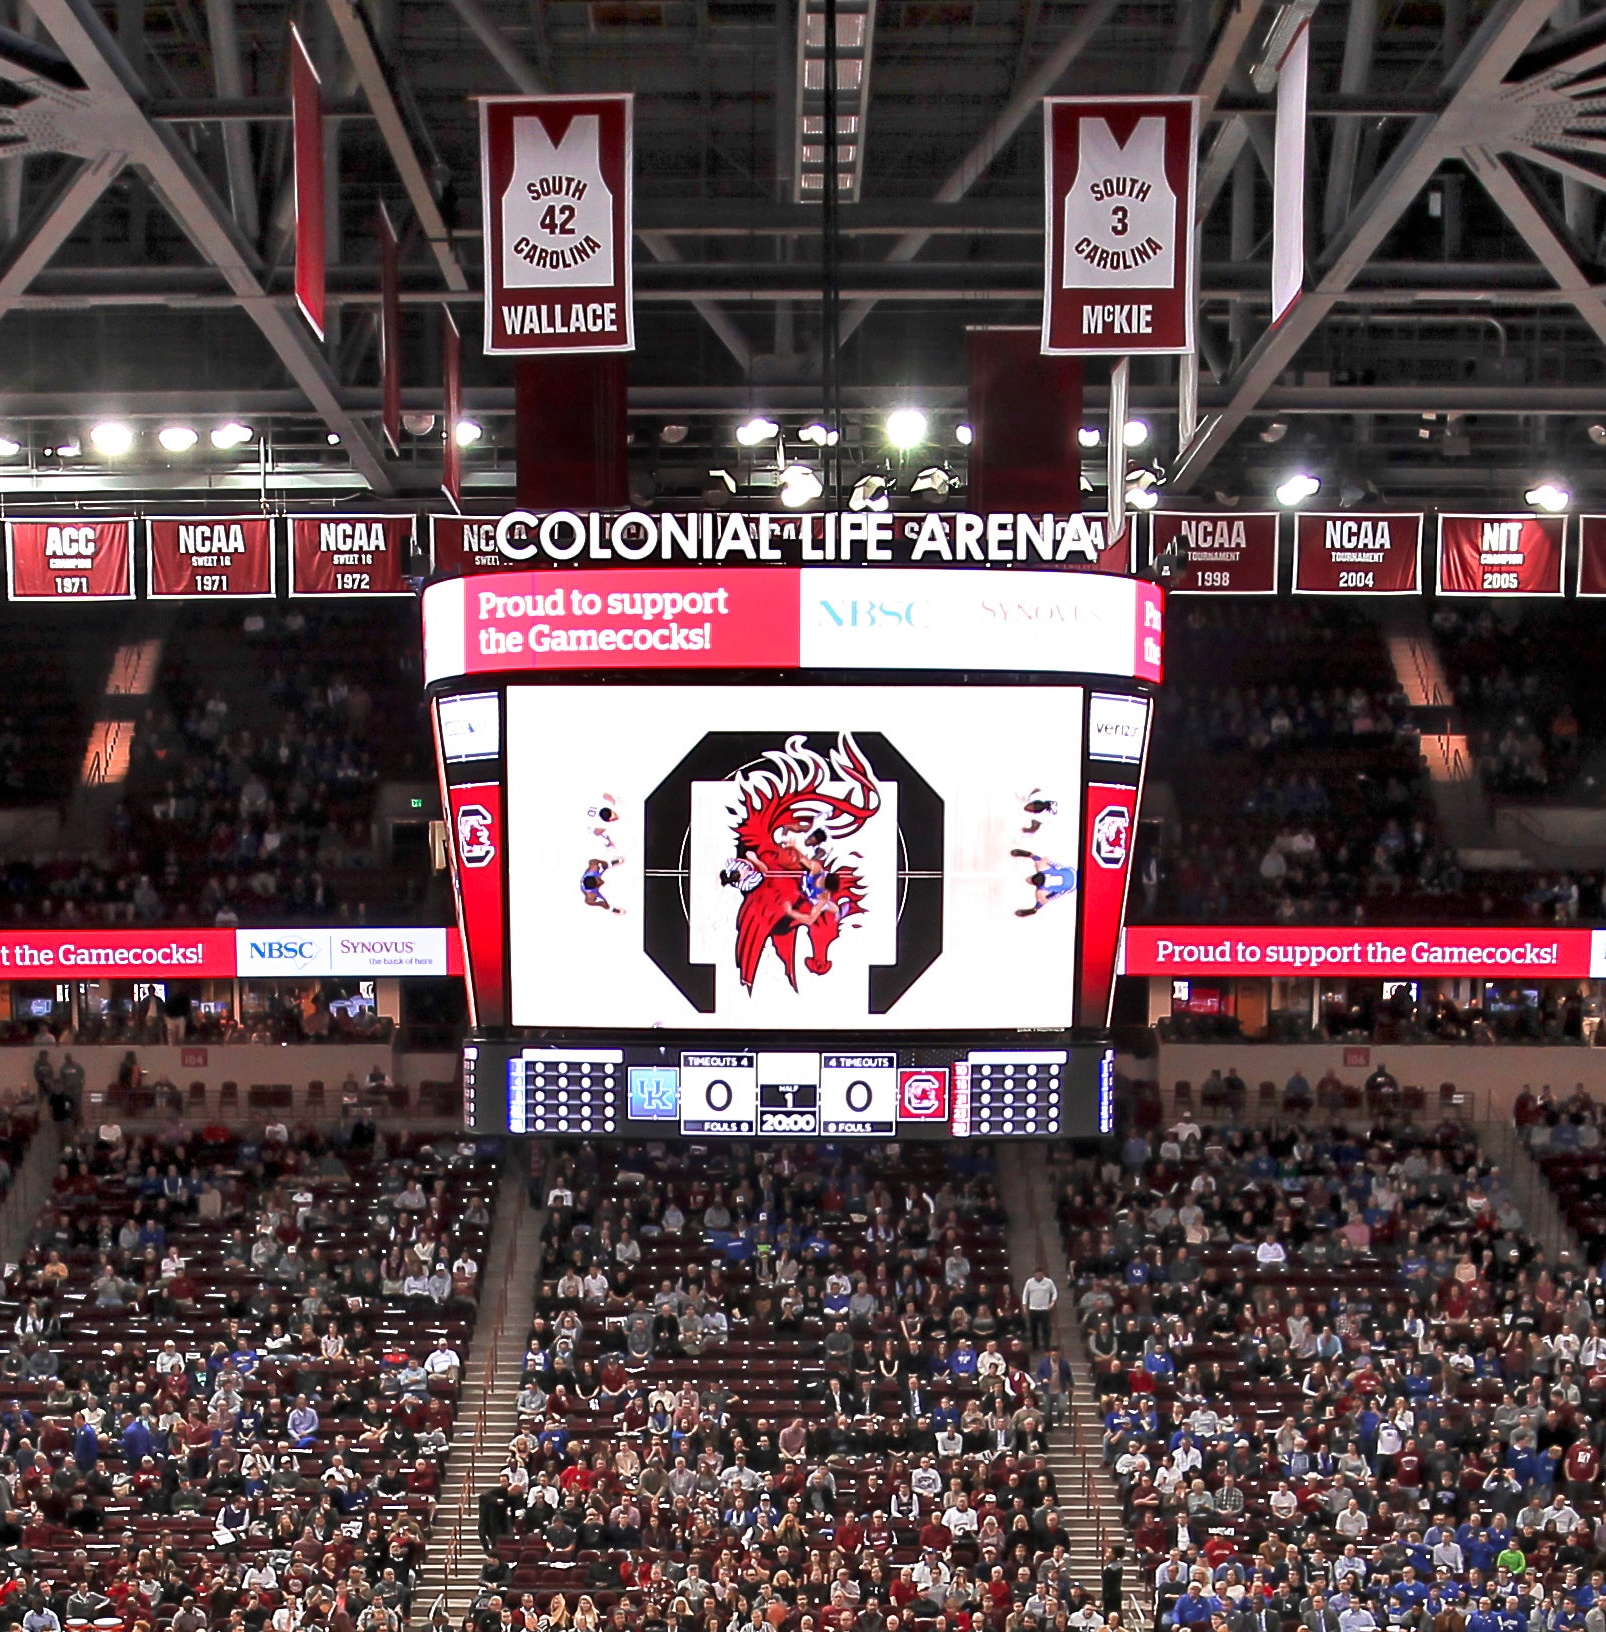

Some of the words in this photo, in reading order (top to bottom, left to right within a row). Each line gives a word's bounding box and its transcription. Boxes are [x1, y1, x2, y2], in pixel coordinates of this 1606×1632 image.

[526, 175, 588, 201] SOUTH
[1090, 176, 1152, 203] SOUTH
[540, 204, 576, 236] 42
[1110, 205, 1129, 237] 3
[513, 235, 602, 270] CAROLINA
[1074, 236, 1163, 271] CAROLINA
[502, 302, 618, 335] WALLACE
[1082, 304, 1153, 335] McKIE
[45, 526, 96, 556] ACC
[179, 524, 245, 554] NCAA
[320, 522, 386, 551] NCAA
[496, 509, 782, 562] COLONIAL
[802, 512, 893, 562] LIFE
[911, 512, 1099, 562] ARENA
[1181, 519, 1247, 548] NCAA
[1325, 520, 1391, 549] NCAA
[1482, 522, 1522, 551] NIT
[191, 556, 219, 567] SWEET
[333, 554, 360, 565] SWEET
[361, 554, 373, 565] 16
[1331, 551, 1384, 563] TOURNAMENT
[55, 577, 89, 594] 1971
[196, 575, 228, 591] 1971
[336, 573, 370, 590] 1972
[1196, 571, 1230, 587] 1998
[1338, 571, 1374, 588] 2004
[1483, 573, 1518, 589] 2005
[478, 588, 565, 619] Proud
[570, 591, 603, 616] to
[607, 587, 729, 620] support
[818, 599, 930, 629] NBSC
[479, 627, 521, 656] the
[528, 622, 711, 653] Gamecocks!
[15, 943, 54, 965] the
[58, 942, 204, 965] Gamecocks!
[249, 941, 314, 959] NBSC
[340, 939, 414, 954] SYNOVUS
[1156, 940, 1231, 963] Proud
[1236, 942, 1260, 962] to
[1265, 941, 1361, 968] support
[1366, 941, 1406, 964] the
[1411, 941, 1558, 965] Gamecocks!
[687, 1056, 738, 1067] TIMEOUTS
[740, 1056, 748, 1067] 4
[829, 1057, 836, 1067] 4
[839, 1057, 889, 1067] TIMEOUTS
[637, 1077, 673, 1110] UK
[705, 1079, 733, 1112] 0
[784, 1092, 793, 1108] 1
[845, 1080, 873, 1112] 0
[704, 1121, 738, 1132] FOULS
[761, 1113, 815, 1132] 20:00
[828, 1122, 836, 1132] 0
[838, 1122, 872, 1132] FOULS
